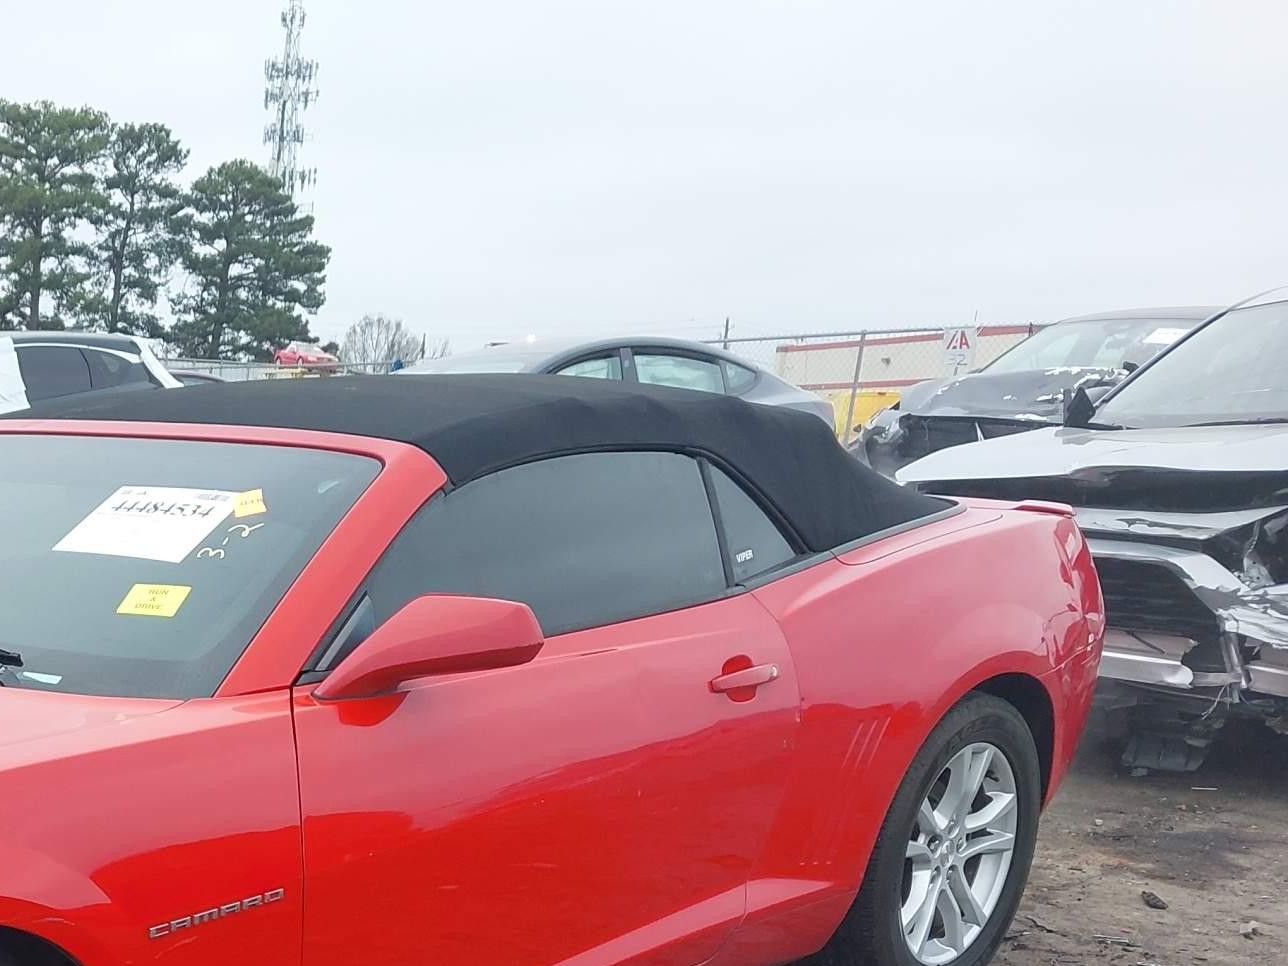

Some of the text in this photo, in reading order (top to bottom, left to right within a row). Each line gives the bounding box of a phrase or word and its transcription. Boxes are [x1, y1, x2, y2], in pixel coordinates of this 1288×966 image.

[112, 500, 215, 517] 44484534
[735, 549, 753, 563] VIPER
[149, 888, 284, 938] CAMARO
